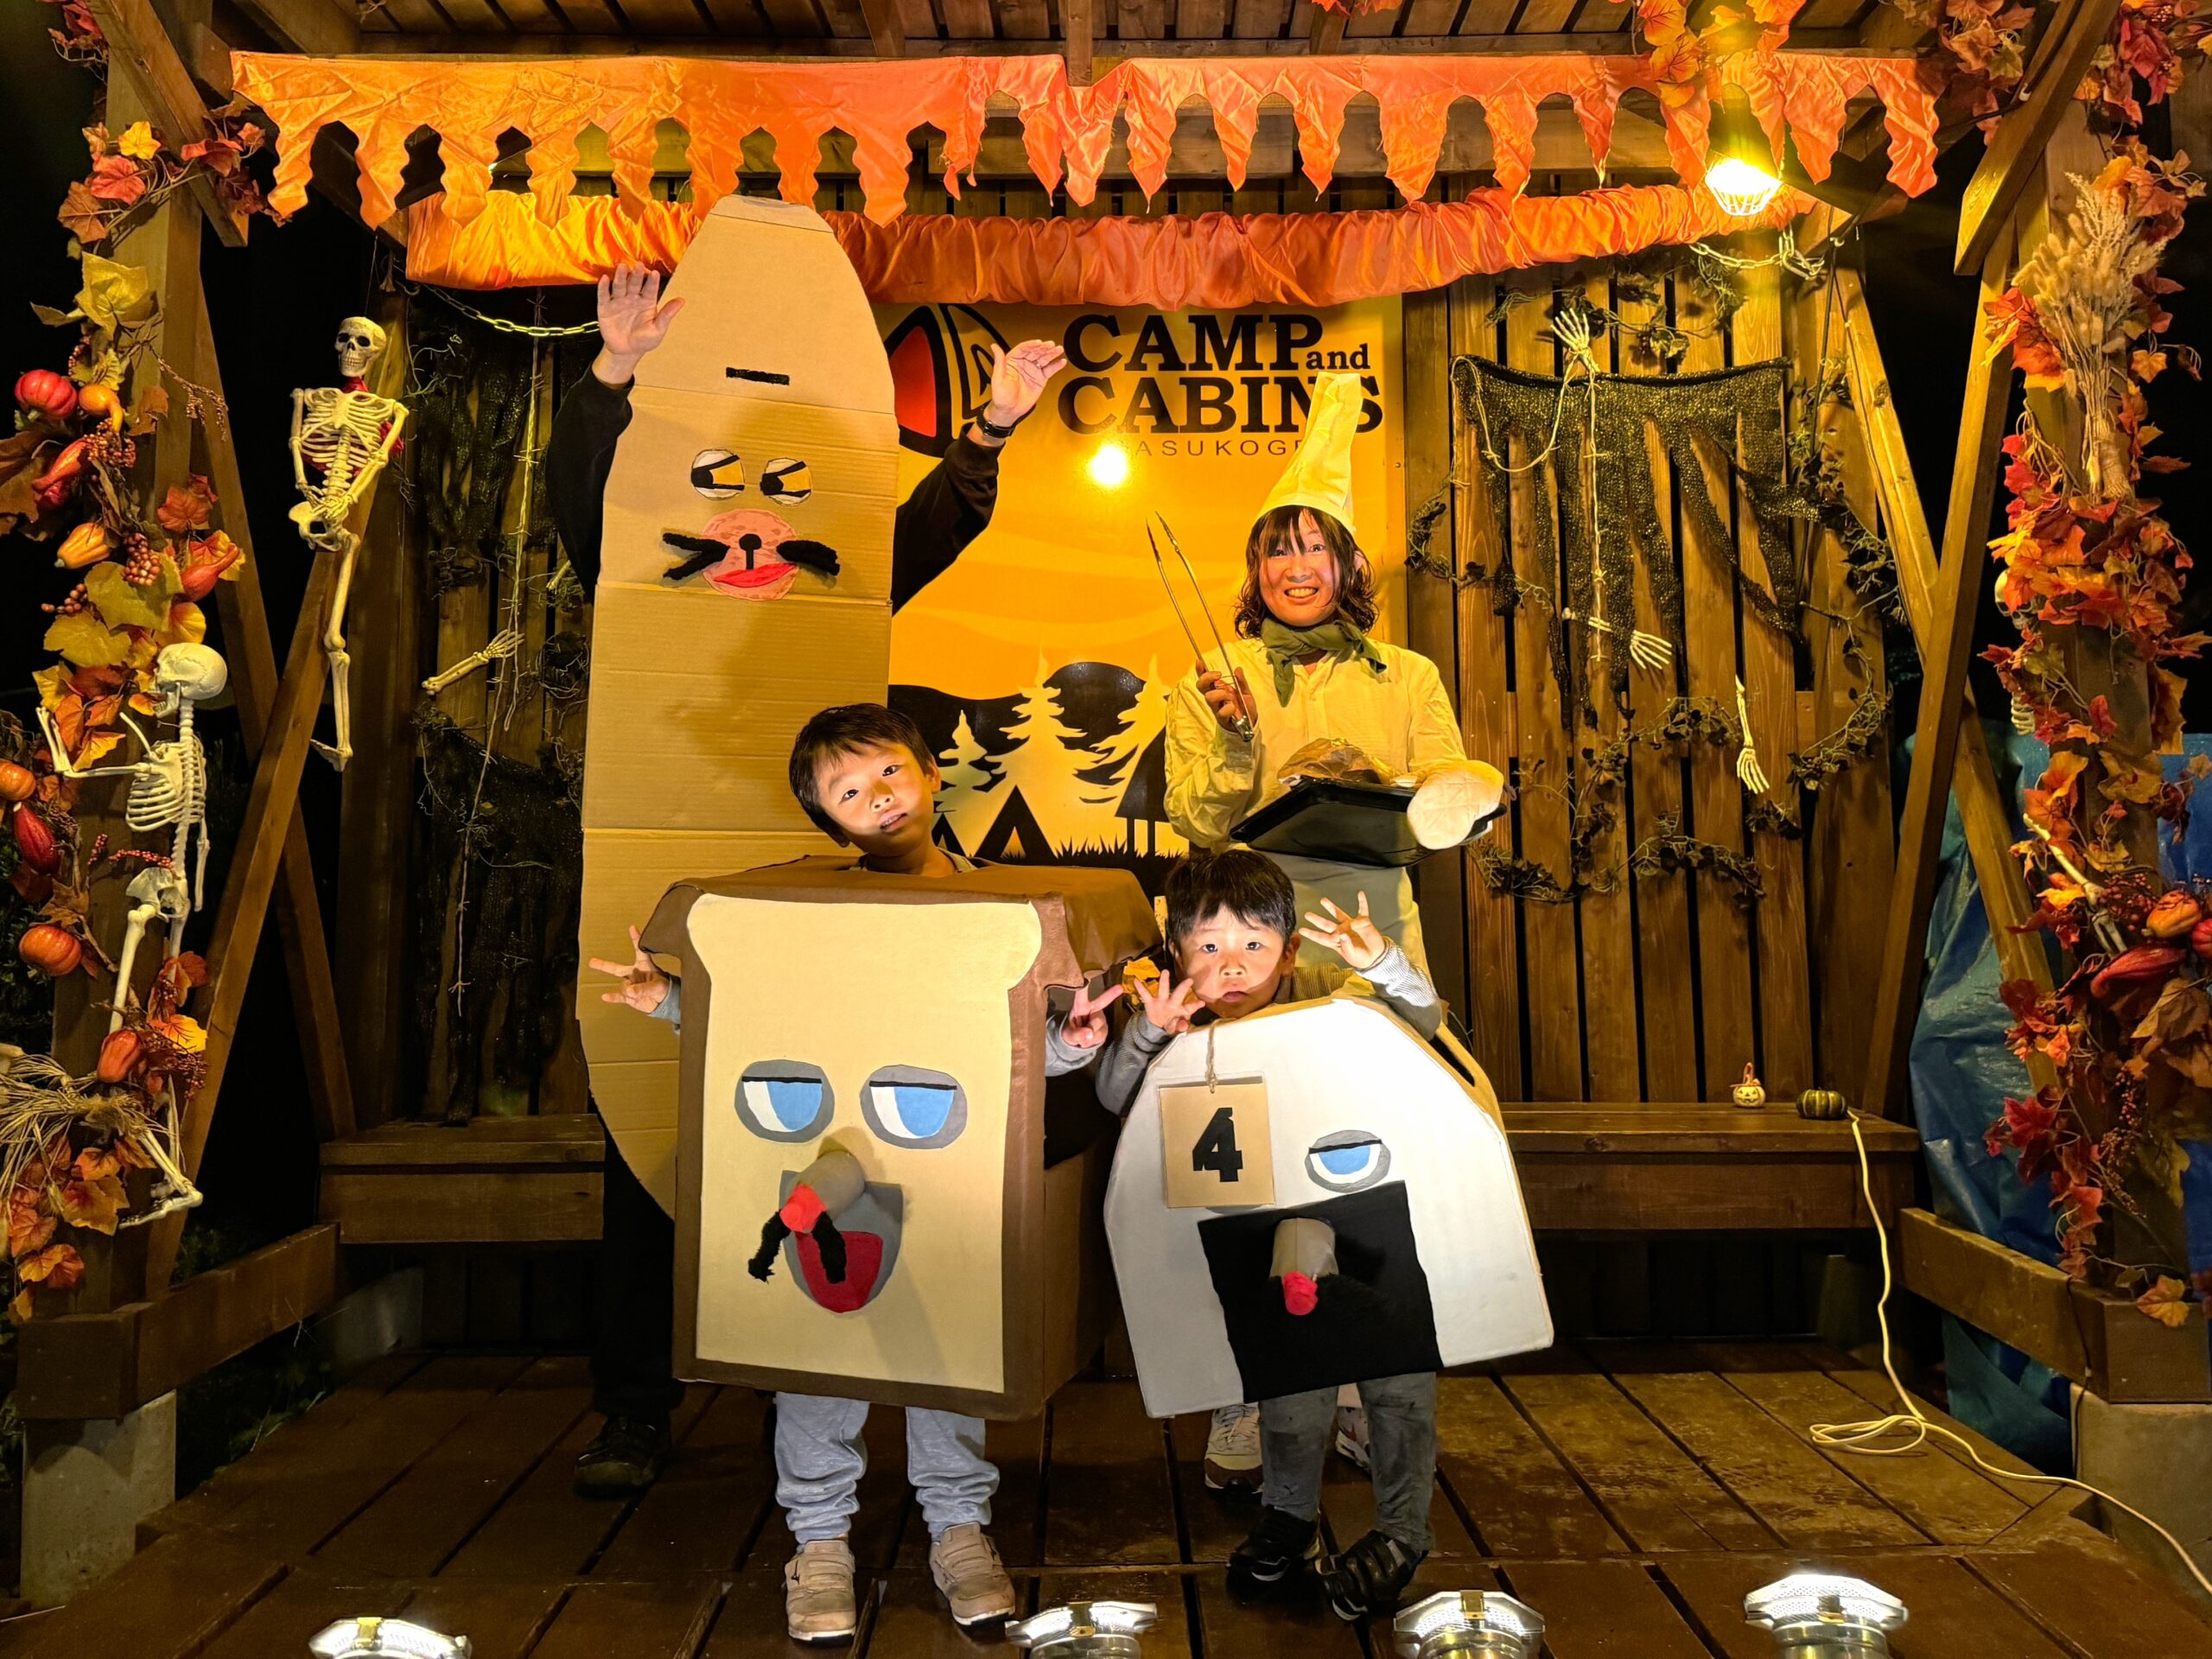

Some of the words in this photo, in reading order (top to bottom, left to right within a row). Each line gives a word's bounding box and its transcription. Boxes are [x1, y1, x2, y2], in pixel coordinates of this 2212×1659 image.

[1063, 314, 1323, 372] CAMP
[1306, 342, 1370, 370] and
[1135, 439, 1303, 456] ASUKOG
[1192, 1107, 1243, 1182] 4
